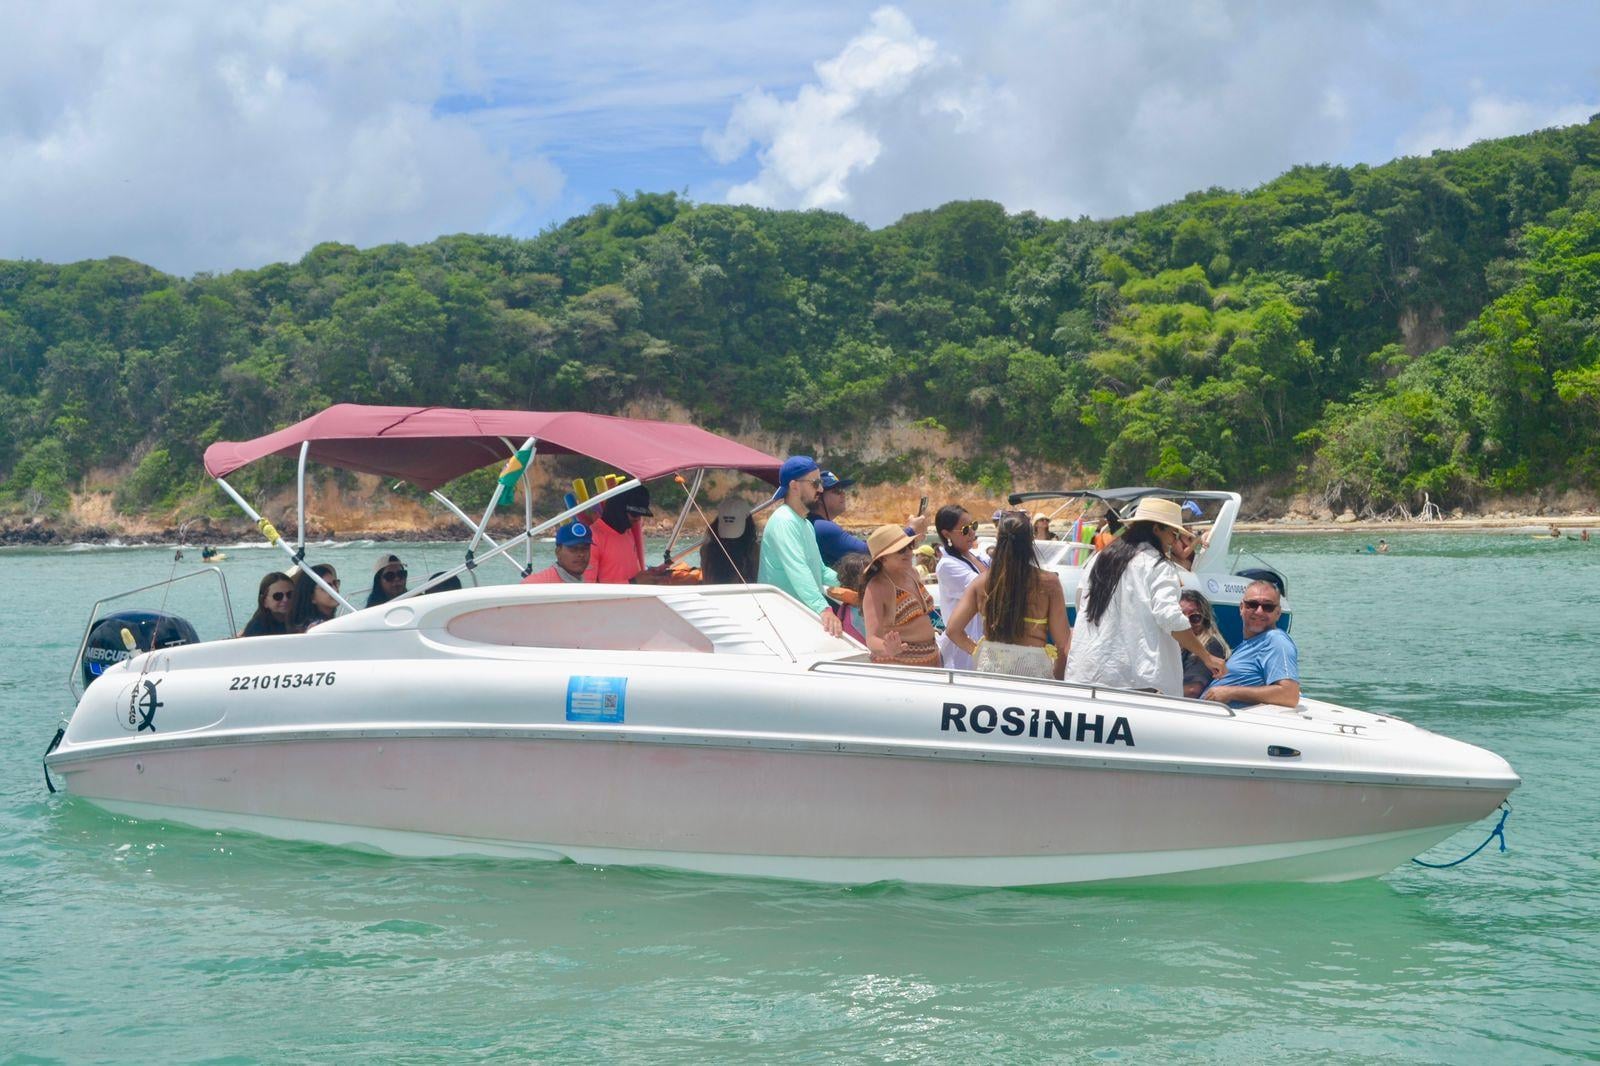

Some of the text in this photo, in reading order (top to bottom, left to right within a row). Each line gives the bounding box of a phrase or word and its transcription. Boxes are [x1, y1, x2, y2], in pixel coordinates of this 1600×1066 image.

[87, 647, 133, 662] MERCUR
[229, 672, 336, 691] 2210153476
[940, 702, 1136, 747] ROSINHA
